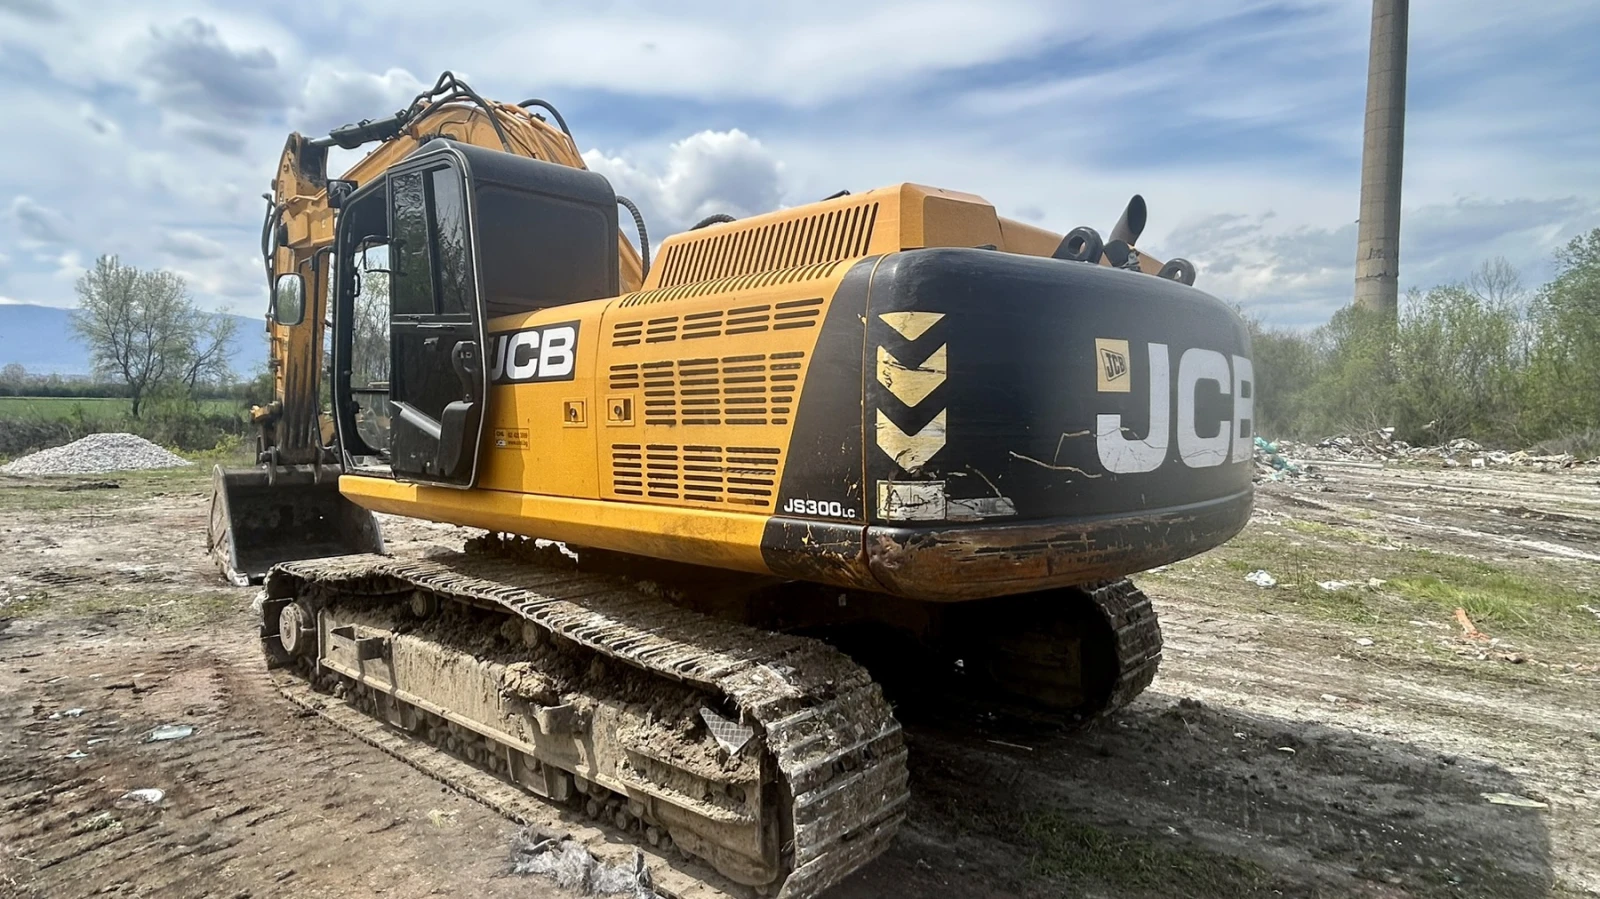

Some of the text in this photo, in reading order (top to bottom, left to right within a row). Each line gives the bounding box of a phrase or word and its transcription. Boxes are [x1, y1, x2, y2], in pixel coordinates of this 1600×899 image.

[491, 326, 576, 380] JCB
[1105, 352, 1126, 378] JCB
[1097, 343, 1254, 474] JCB
